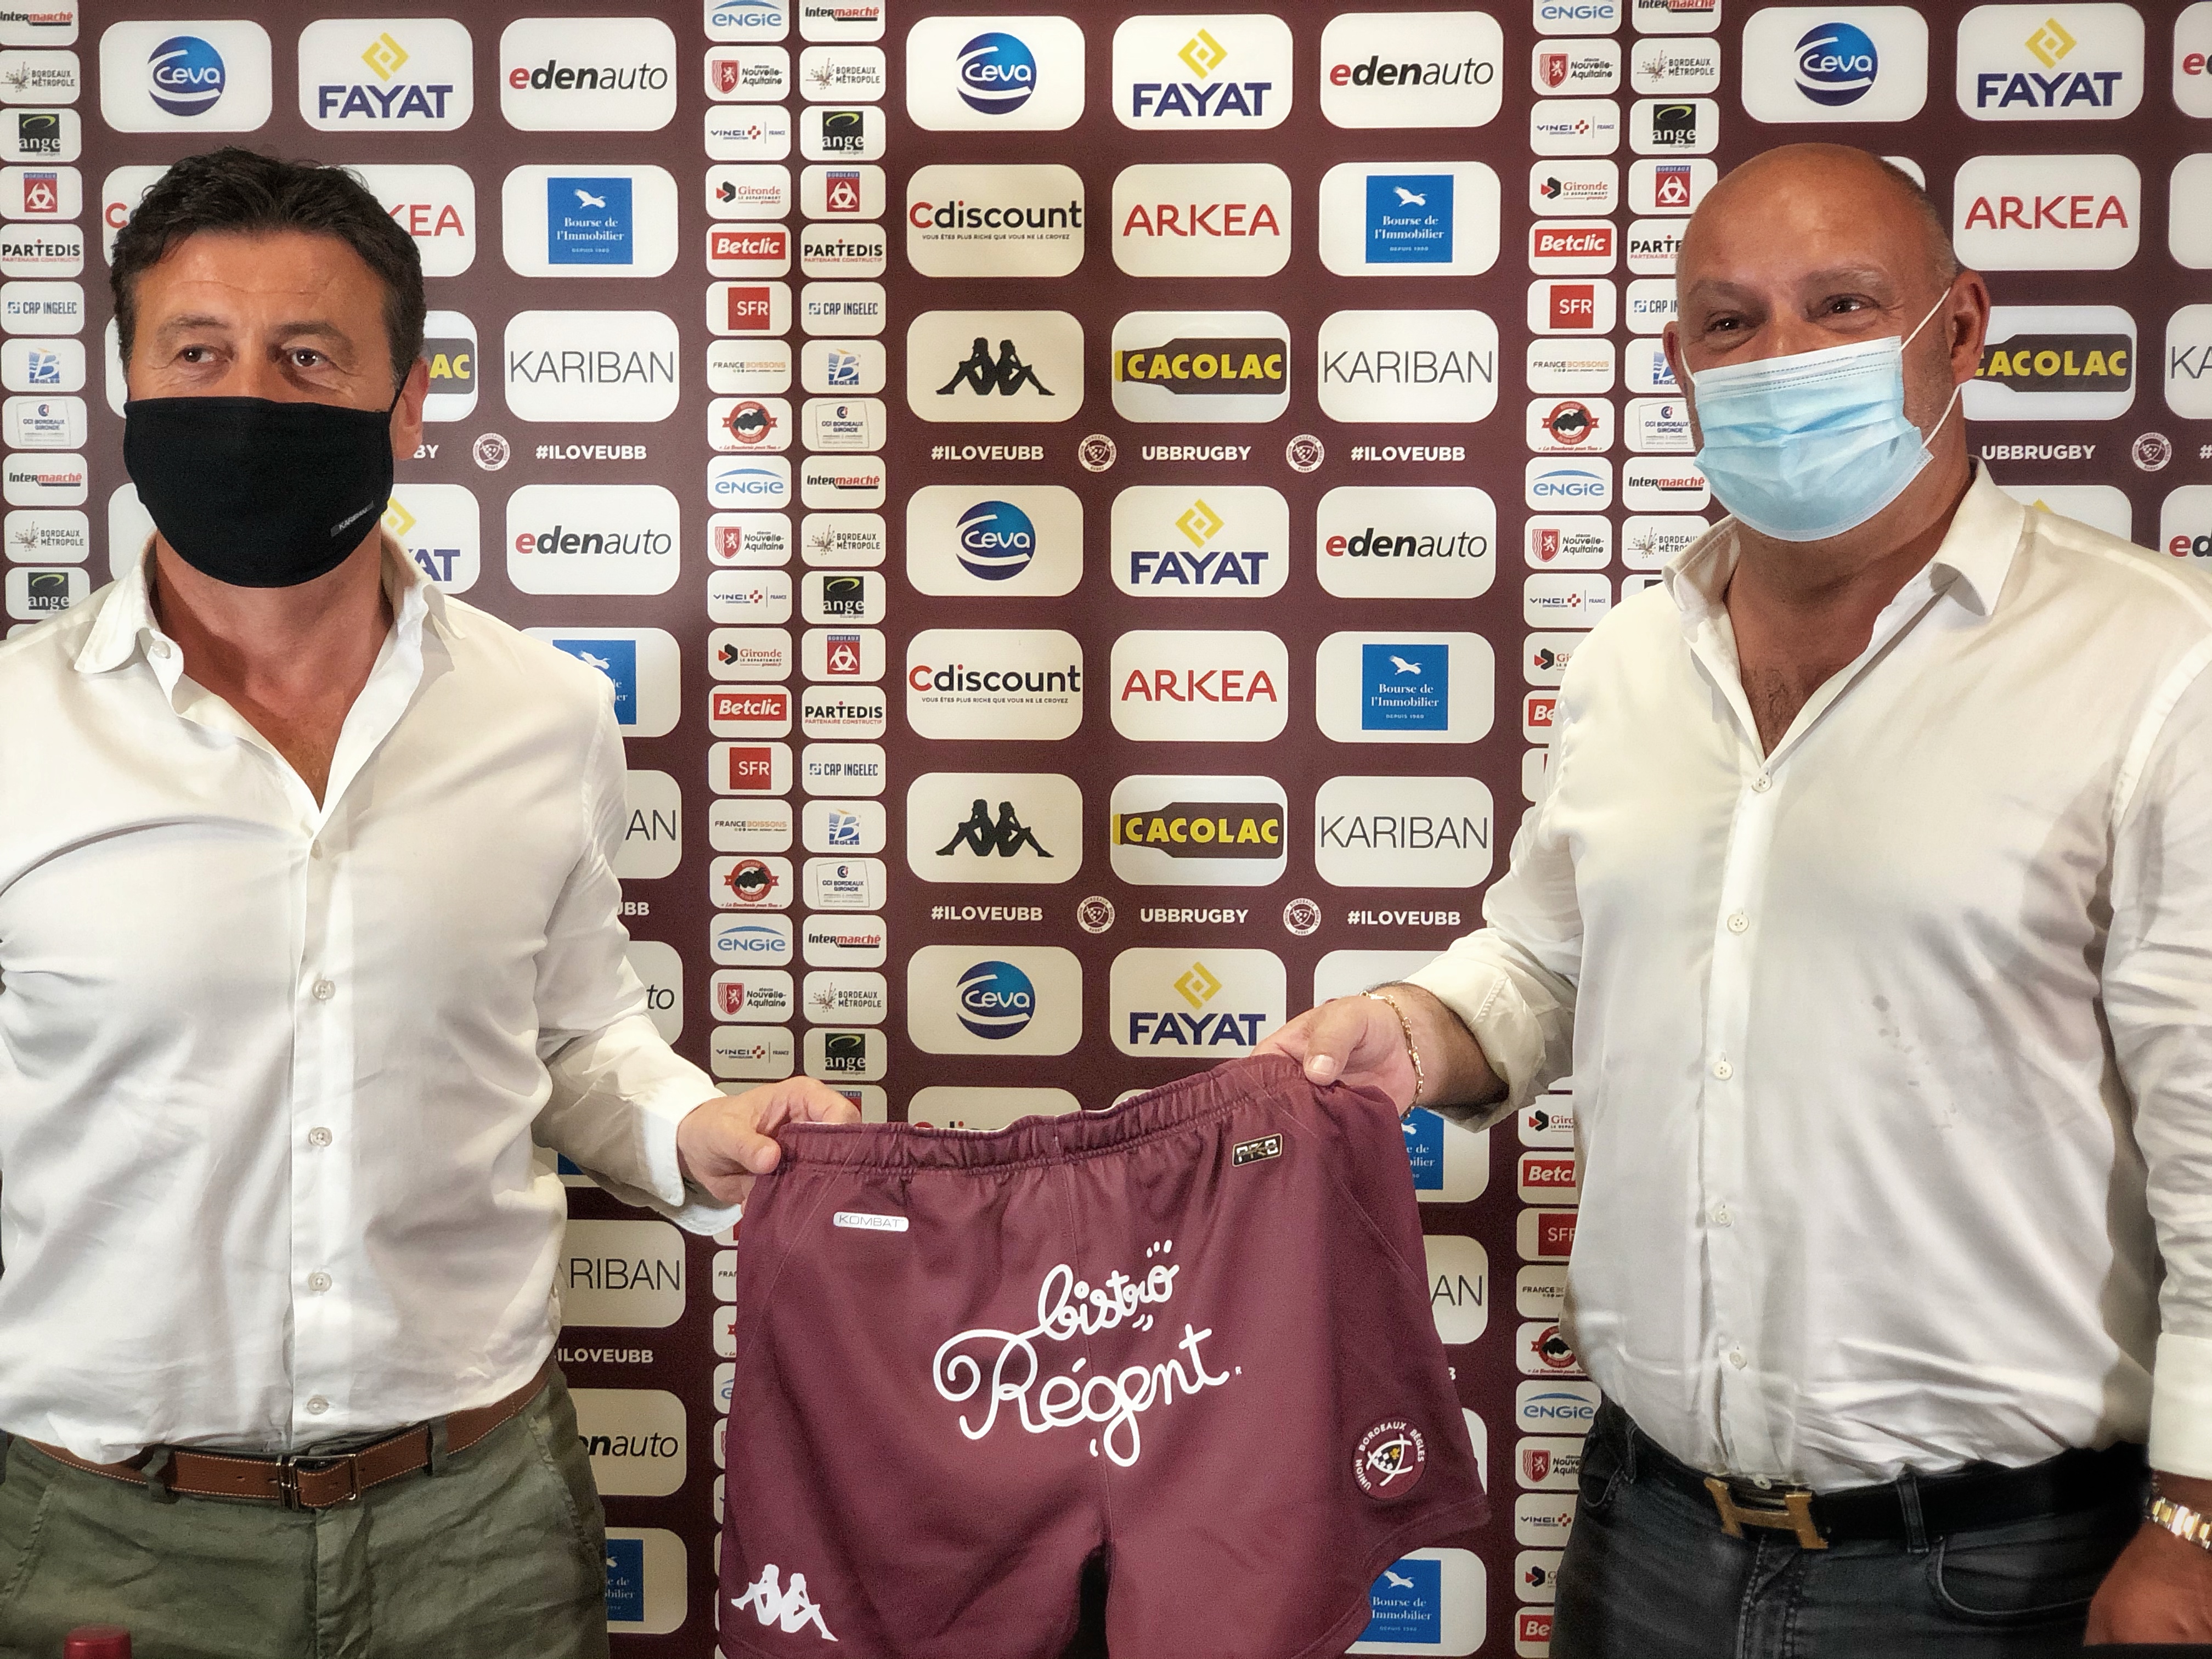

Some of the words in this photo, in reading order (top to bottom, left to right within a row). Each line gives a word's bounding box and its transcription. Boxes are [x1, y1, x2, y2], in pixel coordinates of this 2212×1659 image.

[1669, 59, 1710, 67] BORDEAUX
[1803, 55, 1872, 72] Ceva
[510, 60, 667, 89] edenauto
[963, 61, 1031, 81] Ceva
[1330, 56, 1493, 86] edenauto
[1570, 70, 1613, 80] Aquitaine
[1669, 66, 1714, 76] MÉTROPOLE
[742, 76, 783, 86] Aquitaine
[836, 74, 879, 83] MÉTROPOLE
[1977, 72, 2122, 108] FAYAT
[319, 85, 453, 118] FAYAT
[1133, 83, 1271, 117] FAYAT
[19, 137, 61, 151] ange
[822, 134, 865, 151] ange
[1653, 128, 1696, 146] ange
[738, 186, 780, 195] Gironde
[1564, 182, 1607, 192] Gironde
[910, 201, 1081, 228] Cdiscount
[1965, 196, 2128, 229] ARKEA
[565, 217, 601, 227] Bourse
[605, 218, 618, 227] de
[1123, 204, 1279, 236] ARKEA
[1384, 216, 1421, 225] Bourse
[1425, 216, 1438, 224] de
[557, 231, 624, 240] l'Immobilier
[1375, 229, 1444, 239] l'Immobilier
[717, 238, 780, 253] Betclic
[1540, 234, 1605, 251] Betclic
[2, 244, 80, 256] PARTEDIS
[804, 245, 882, 256] PARTEDIS
[23, 302, 40, 314] CAP
[43, 302, 77, 314] INGELEC
[737, 301, 768, 316] SFR
[824, 303, 840, 315] CAP
[844, 303, 878, 315] INGELEC
[1559, 300, 1592, 314] SFR
[1650, 301, 1667, 313] CAP
[511, 351, 673, 382] KARIBAN
[1128, 354, 1282, 381] CACOLAC
[1324, 351, 1492, 383] KARIBAN
[1975, 349, 2128, 377] ACOLAC
[536, 445, 646, 459] #ILOVEUBB
[931, 446, 1043, 460] #ILOVEUBB
[1143, 447, 1251, 460] UBBRUGBY
[1351, 447, 1465, 461] #ILOVEUBB
[1980, 445, 2096, 462] UBBRUGBY
[806, 474, 881, 487] Intermarché
[1628, 476, 1705, 488] Intermarché
[41, 537, 83, 546] MÉTROPOLE
[516, 526, 671, 554] edenauto
[744, 542, 785, 551] Aquitaine
[837, 540, 880, 549] MÉTROPOLE
[963, 531, 1030, 549] Ceva
[1326, 528, 1487, 557] edenauto
[1562, 537, 1605, 545] Nouvelle-
[1562, 546, 1604, 555] Aquitaine
[1131, 551, 1268, 584] FAYAT
[28, 595, 70, 611] ange
[823, 599, 865, 616] ange
[740, 649, 781, 657] Gironde
[910, 664, 1080, 692] Cdiscount
[1121, 670, 1277, 702] ARKEA
[1380, 684, 1416, 693] Bourse
[1420, 684, 1433, 693] de
[719, 699, 781, 715] Betclic
[1372, 697, 1439, 706] l'Immobilier
[805, 706, 882, 718] PARTEDIS
[738, 761, 769, 776] SFR
[825, 764, 841, 775] CAP
[844, 764, 878, 776] INGELEC
[1124, 818, 1278, 847] CACOLAC
[1322, 816, 1487, 848] KARIBAN
[932, 906, 1042, 921] #ILOVEUBB
[1141, 909, 1248, 923] UBBRUGBY
[1347, 911, 1460, 925] #ILOVEUBB
[809, 933, 881, 944] Intermarché
[747, 999, 786, 1008] Aquitaine
[838, 998, 881, 1007] MÉTROPOLE
[964, 989, 1030, 1009] Ceva
[1130, 1012, 1266, 1046] FAYAT
[825, 1056, 866, 1071] ange
[839, 1214, 900, 1228] KOMBAT
[568, 1257, 681, 1292] RIBAN
[557, 1347, 654, 1364] ILOVEUBB
[933, 1323, 1230, 1468] Régent
[1358, 1421, 1407, 1452] BORDEAUX
[584, 1431, 679, 1458] nauto
[1355, 1459, 1371, 1491] UNION
[1372, 1596, 1410, 1607] Bourse
[1413, 1596, 1427, 1607] de
[1372, 1609, 1432, 1621] Immobilier
